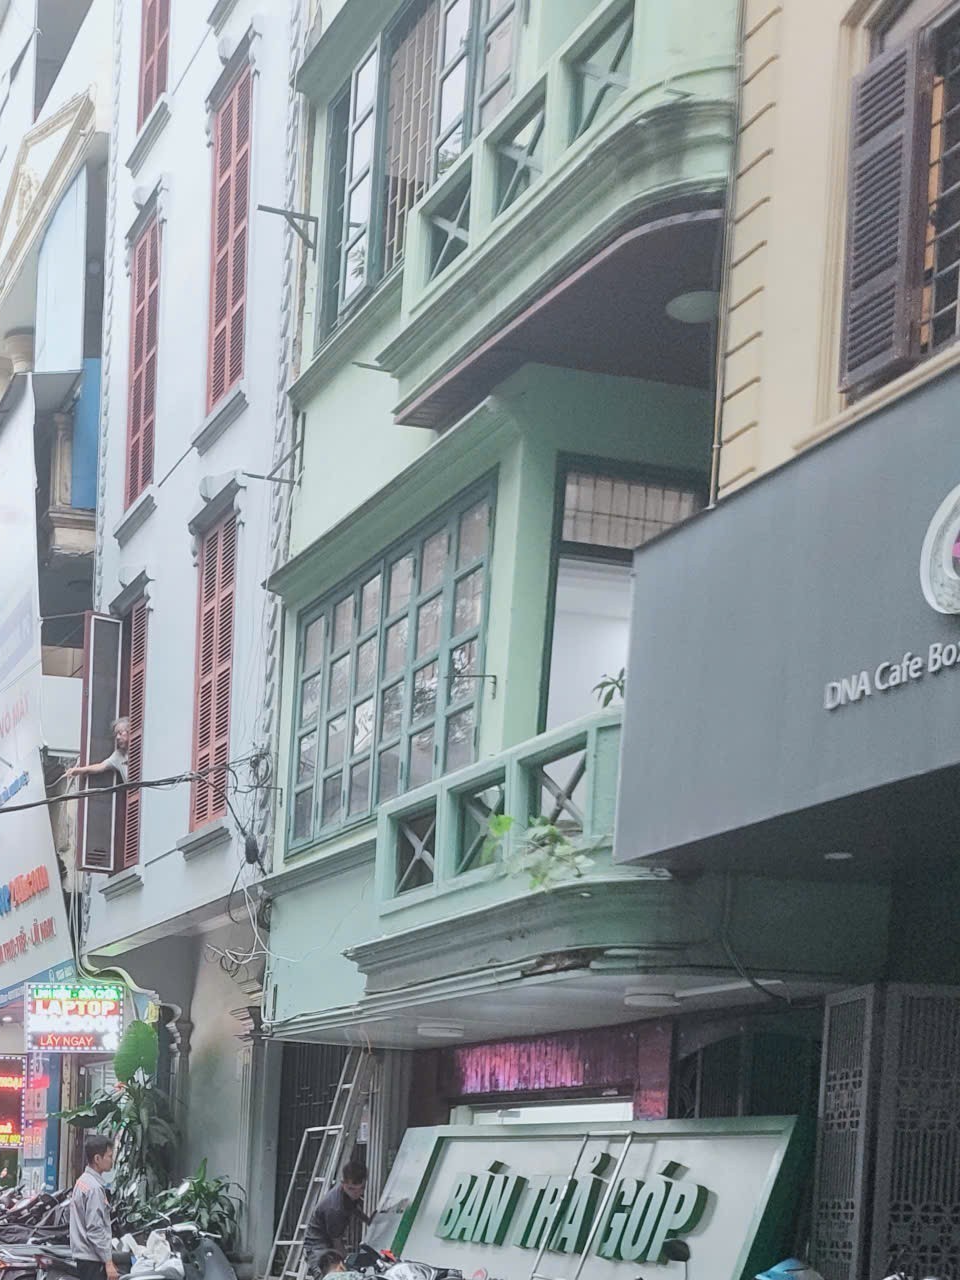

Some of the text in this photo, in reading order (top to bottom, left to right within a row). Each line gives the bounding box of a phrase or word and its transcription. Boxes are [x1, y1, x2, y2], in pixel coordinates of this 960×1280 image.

[824, 670, 872, 710] DNA
[874, 651, 922, 690] Cafe
[35, 999, 116, 1016] LAPTOP
[40, 1033, 93, 1046] LẤY NGAY
[436, 1152, 708, 1264] BÁN TRẢ GÓP
